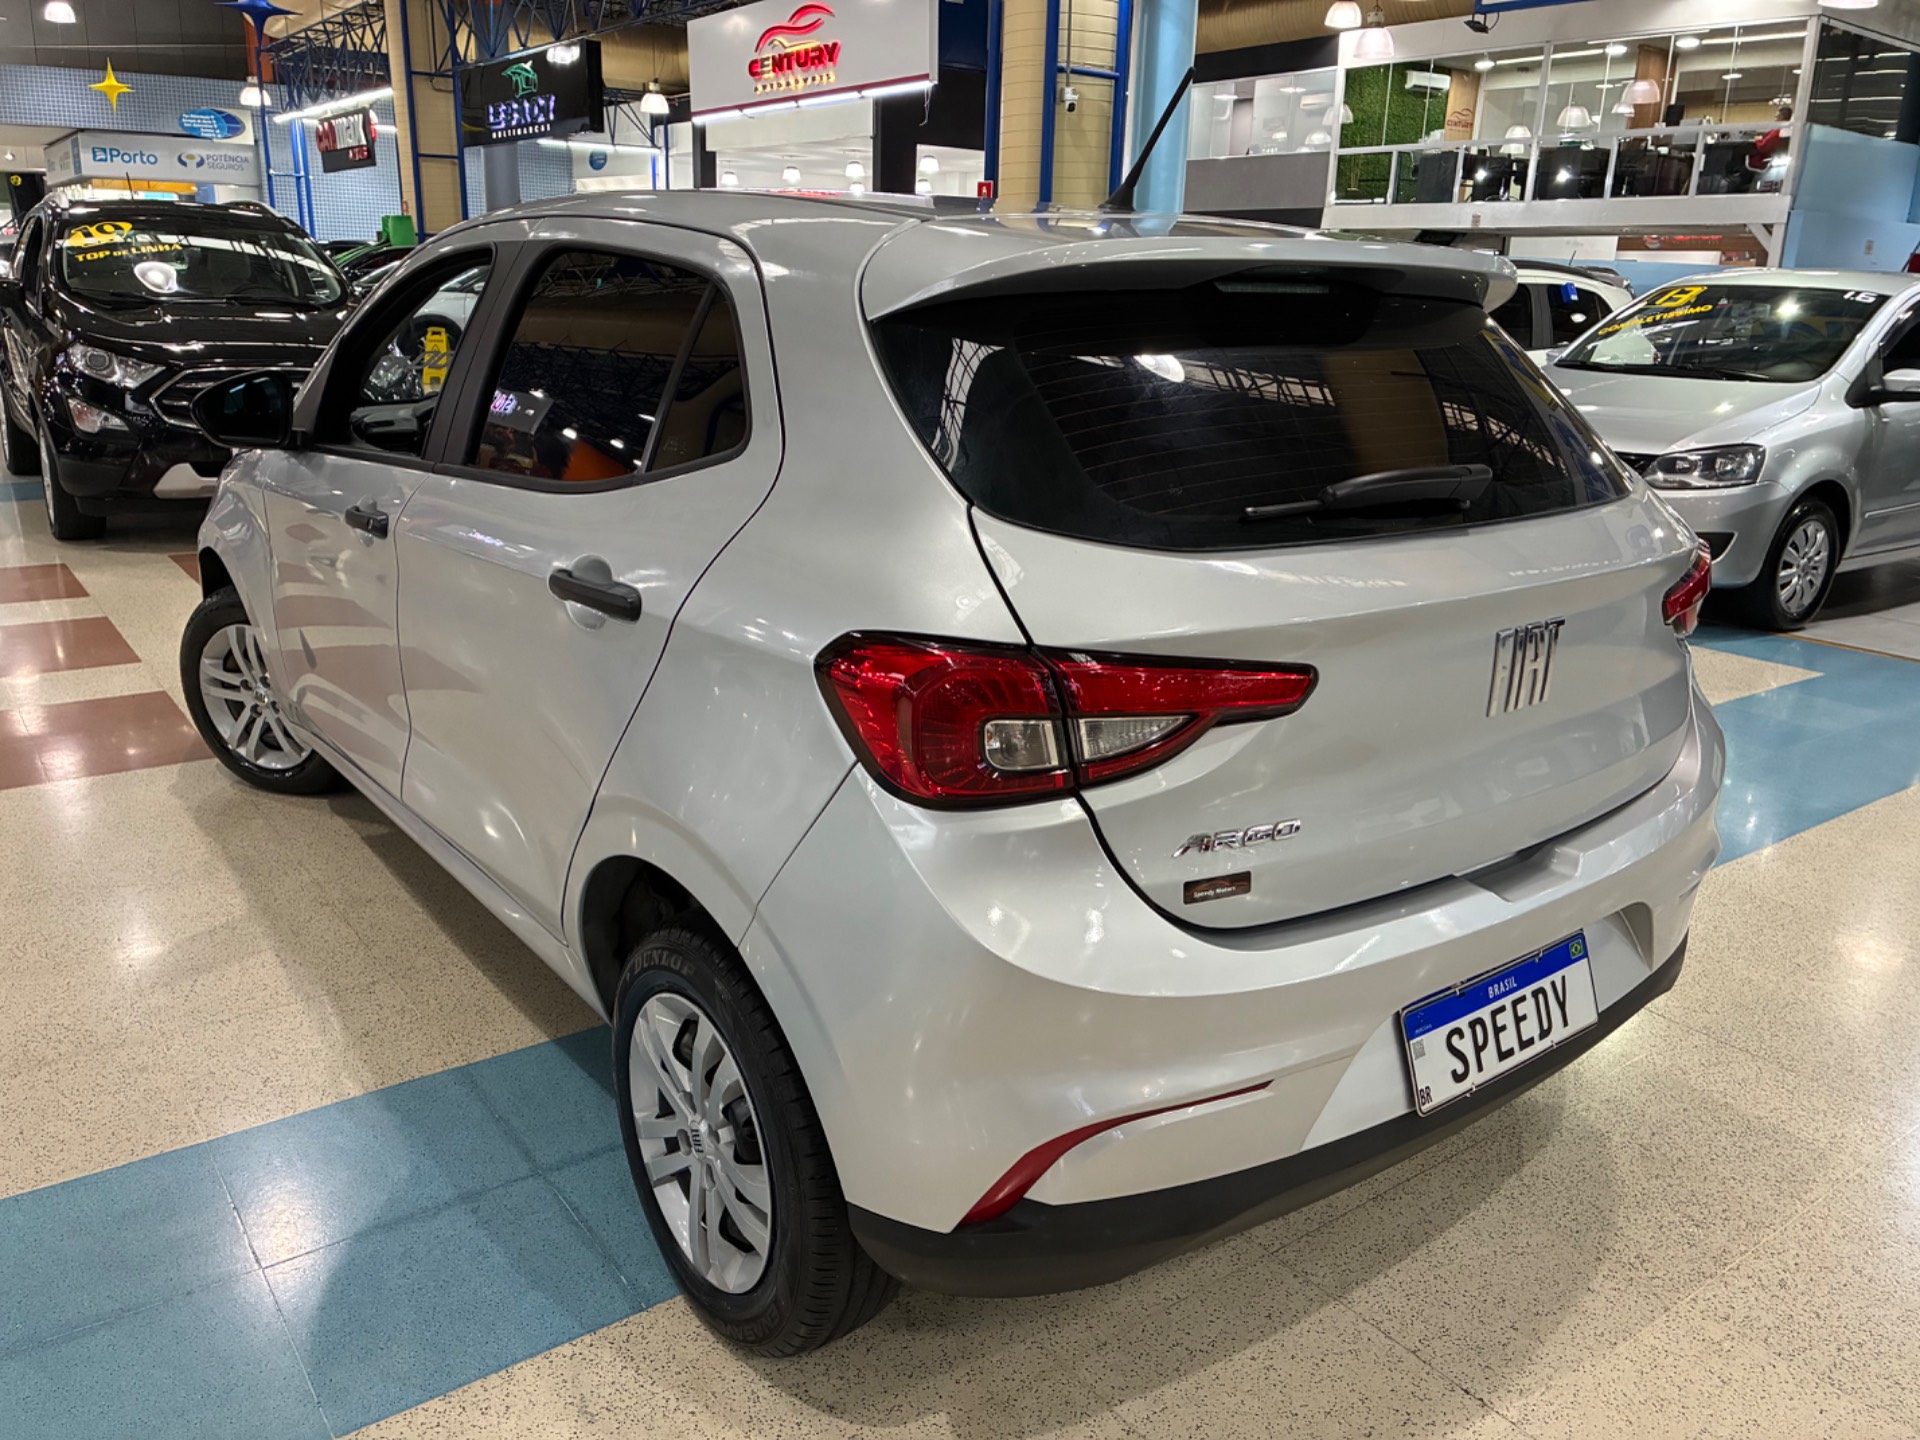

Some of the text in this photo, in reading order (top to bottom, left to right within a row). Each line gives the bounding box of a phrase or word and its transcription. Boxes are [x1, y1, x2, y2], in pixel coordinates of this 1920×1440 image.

[748, 42, 840, 78] CENTURY
[486, 95, 555, 128] LEGACY
[110, 148, 159, 165] Porto
[206, 153, 250, 164] POTÊNCIA
[206, 162, 245, 171] SEGUROS
[75, 250, 111, 262] TOP
[131, 243, 183, 255] LINHA
[1843, 290, 1878, 303] 1.6
[1486, 617, 1565, 717] FIAT
[1171, 818, 1301, 858] ARGO
[1488, 975, 1518, 999] BRASIL
[1446, 974, 1569, 1084] SPEEDY
[1419, 1085, 1433, 1106] BR
